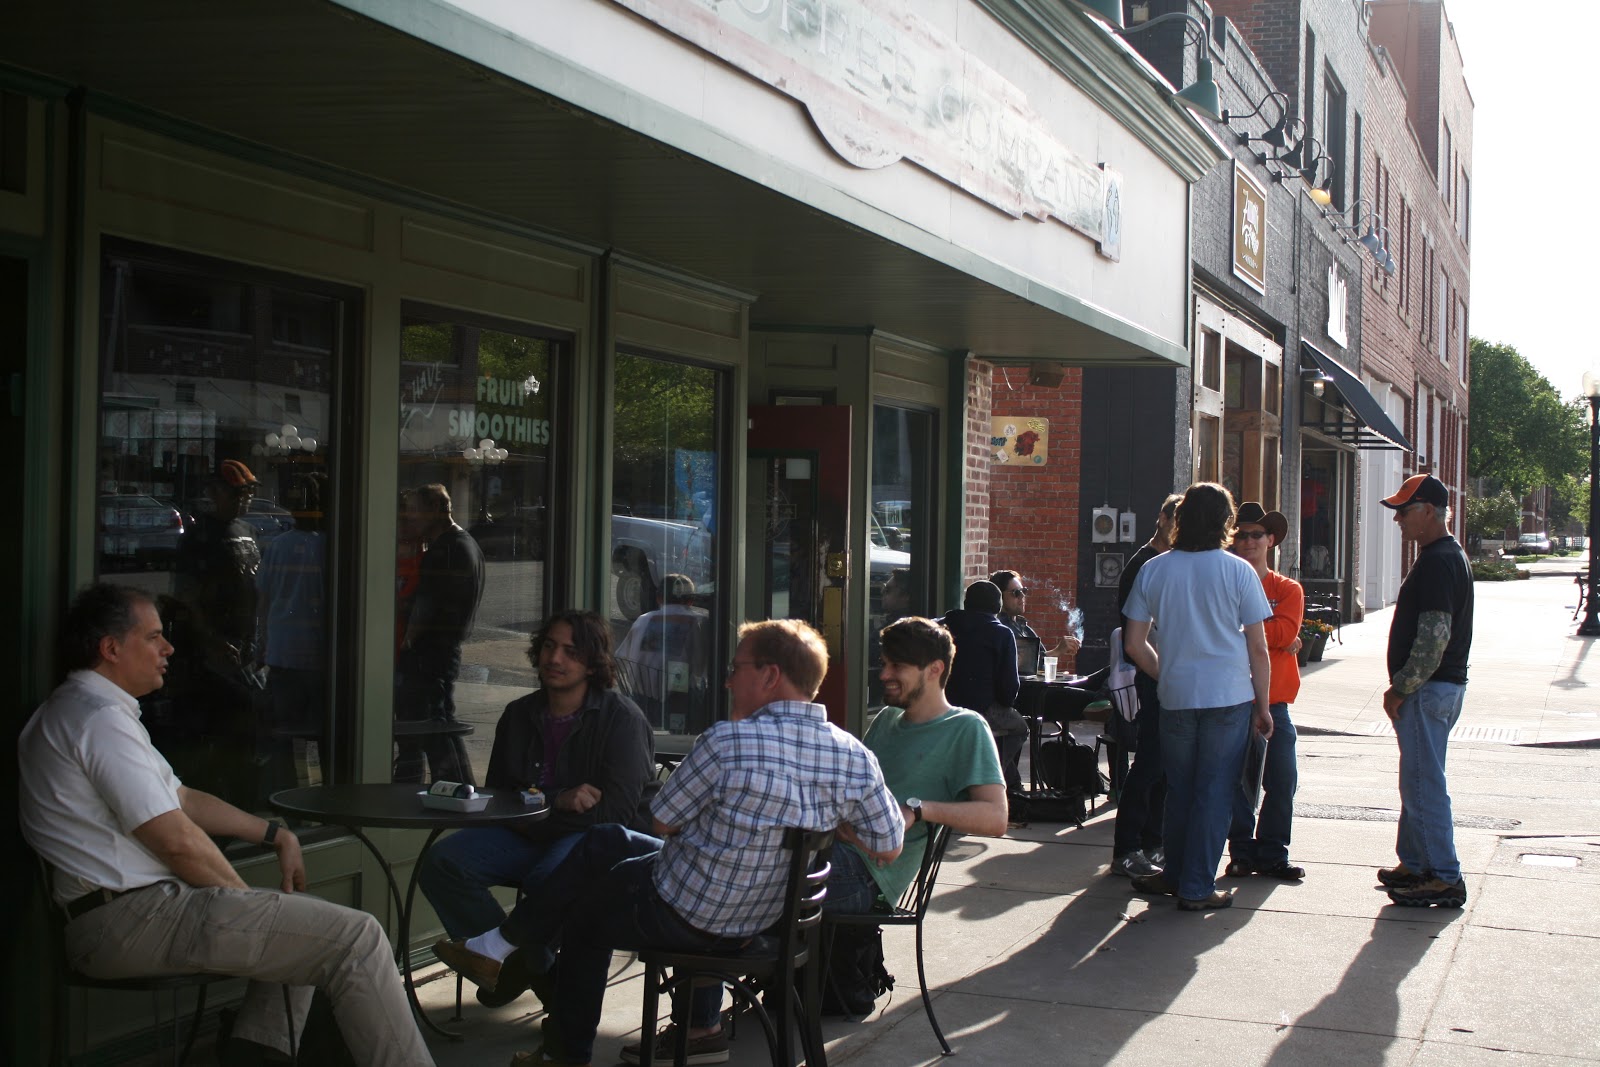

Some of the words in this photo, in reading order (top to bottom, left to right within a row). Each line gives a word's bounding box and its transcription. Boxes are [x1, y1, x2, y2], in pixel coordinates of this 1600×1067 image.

[736, 0, 918, 109] FFEE
[938, 81, 1103, 210] COMPANY
[476, 375, 527, 407] FRUIT
[448, 409, 550, 445] SMOOTHIES
